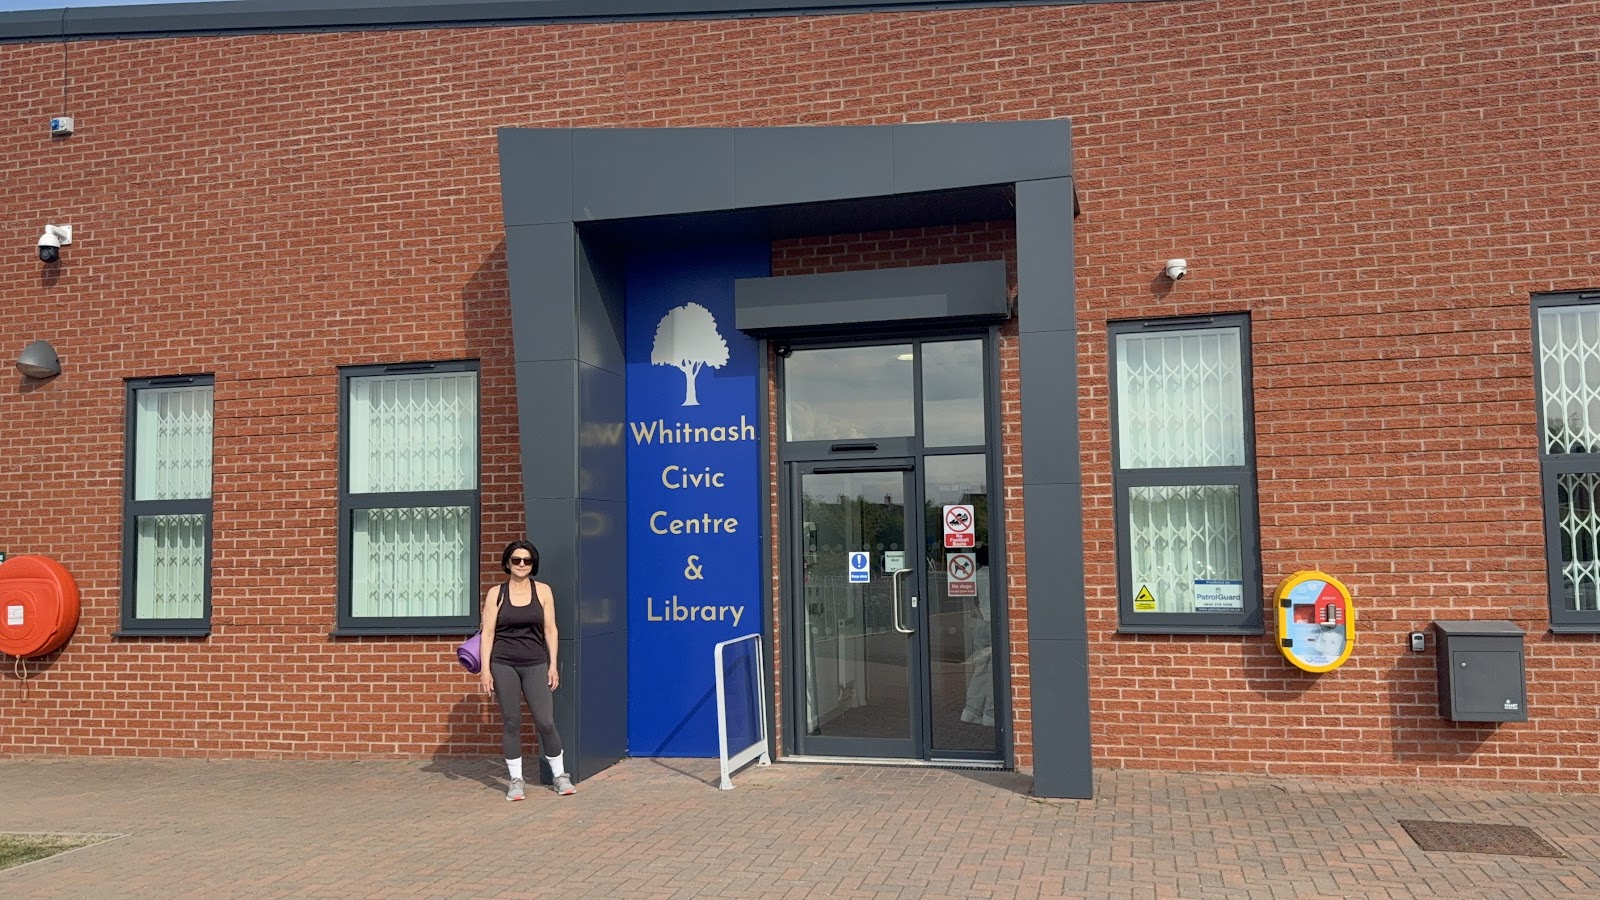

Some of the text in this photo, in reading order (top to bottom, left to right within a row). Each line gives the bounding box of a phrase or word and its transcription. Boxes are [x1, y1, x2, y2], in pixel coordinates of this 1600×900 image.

[630, 415, 755, 446] Whitnash
[661, 465, 725, 490] Civic
[649, 510, 739, 535] Centre
[684, 554, 705, 580] &
[647, 595, 744, 627] Library
